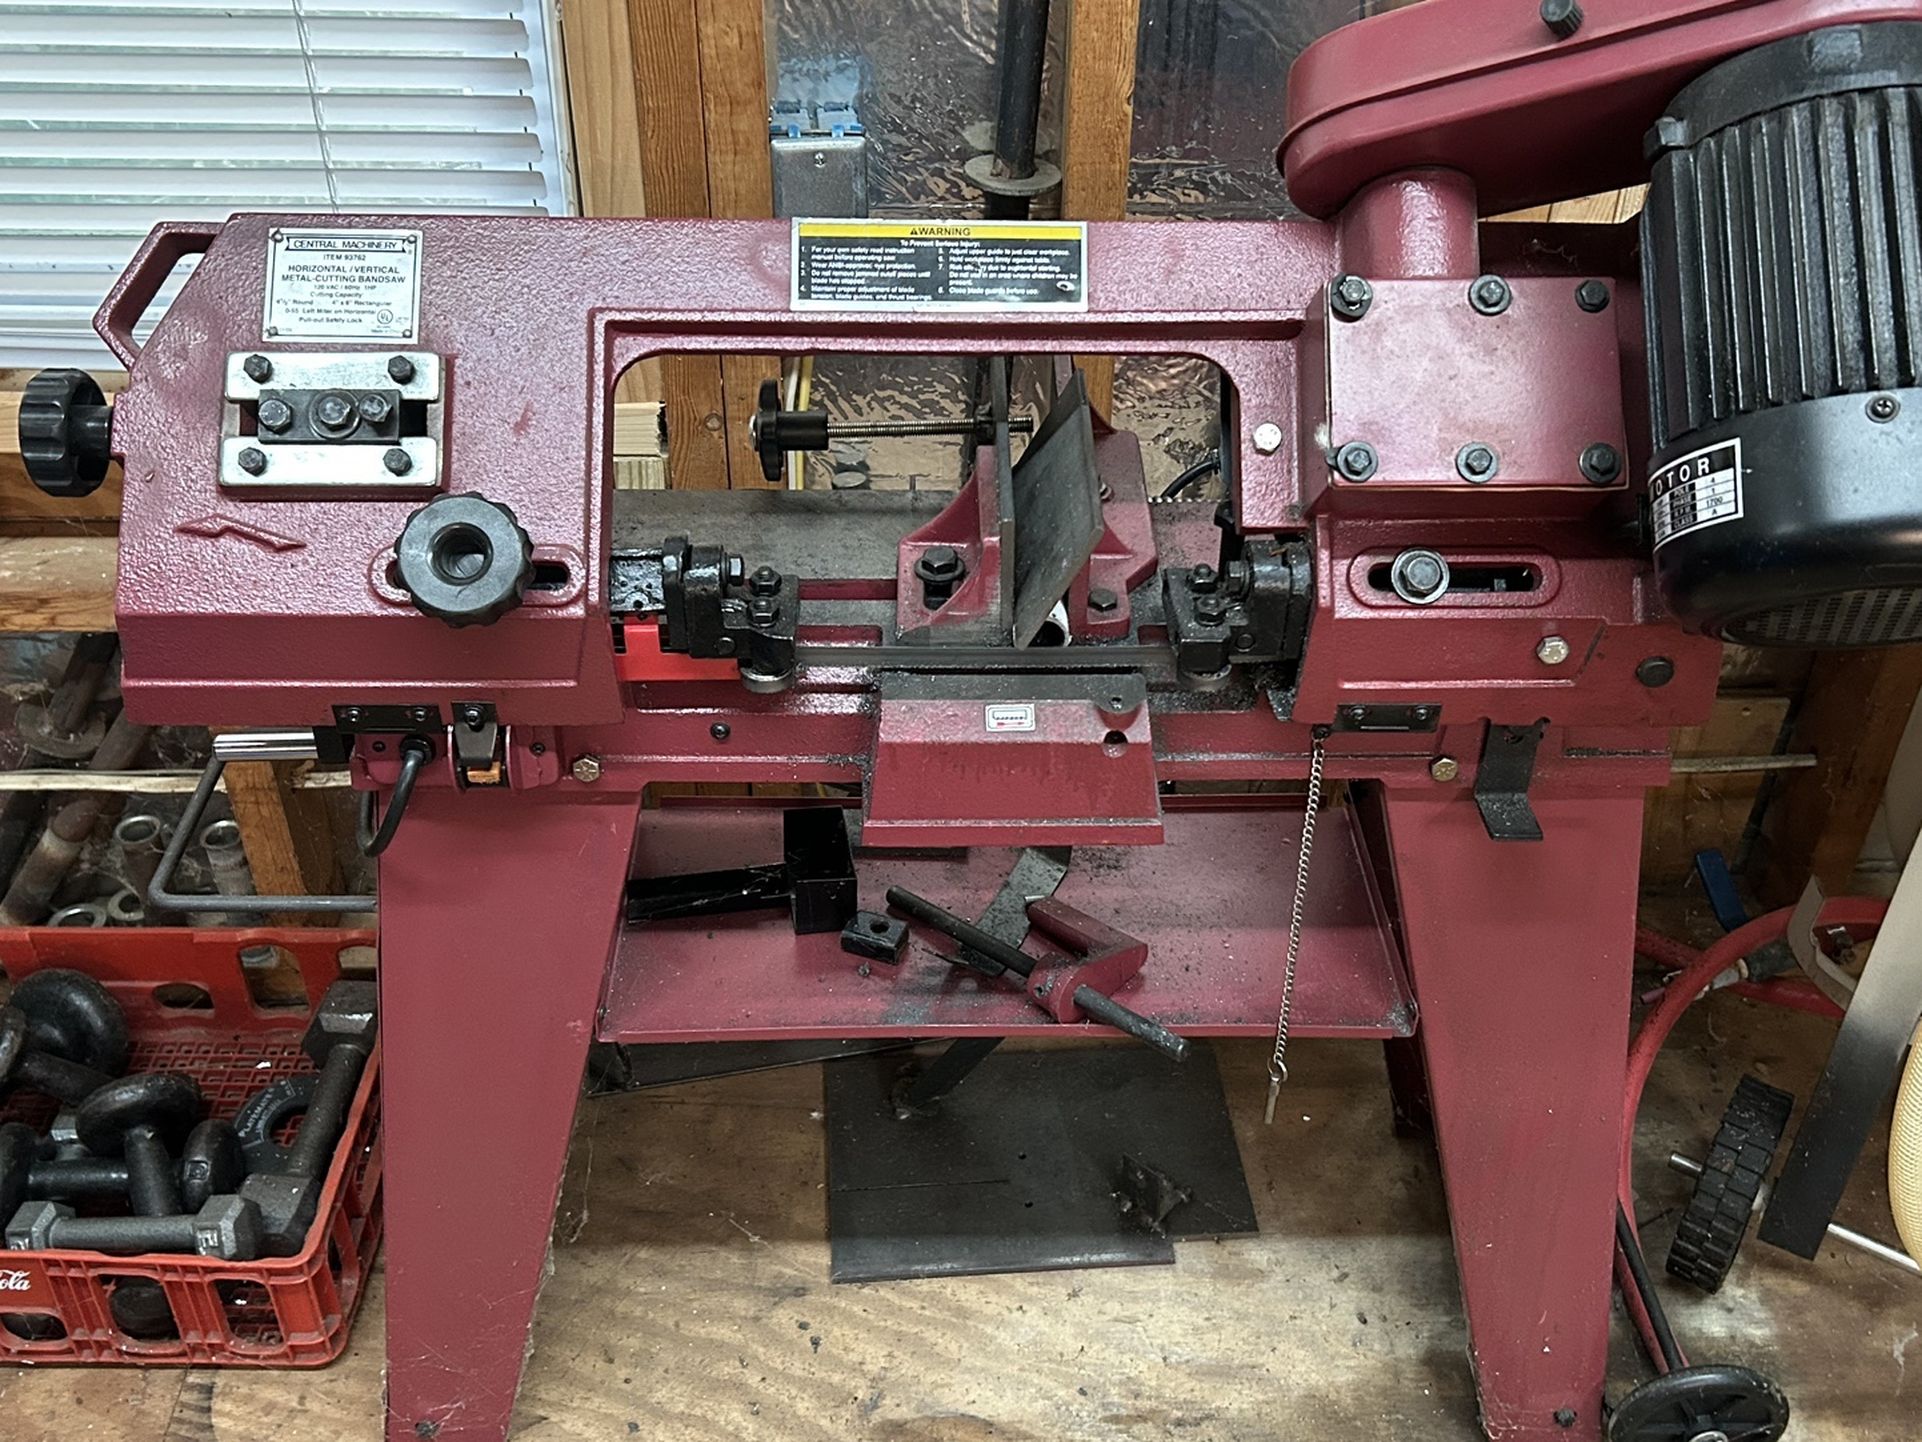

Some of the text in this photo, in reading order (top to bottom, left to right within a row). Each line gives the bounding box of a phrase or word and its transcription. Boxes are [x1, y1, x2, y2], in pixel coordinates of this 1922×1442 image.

[918, 227, 970, 236] WARNING
[294, 240, 397, 249] CENTRAL MACHINERY
[288, 265, 347, 273] HORIZONTAL
[282, 274, 356, 282] METAL-CUTTING
[1706, 496, 1724, 509] 1700
[1673, 514, 1694, 529] CLASS
[1711, 508, 1718, 516] A
[0, 1269, 31, 1291] ola
